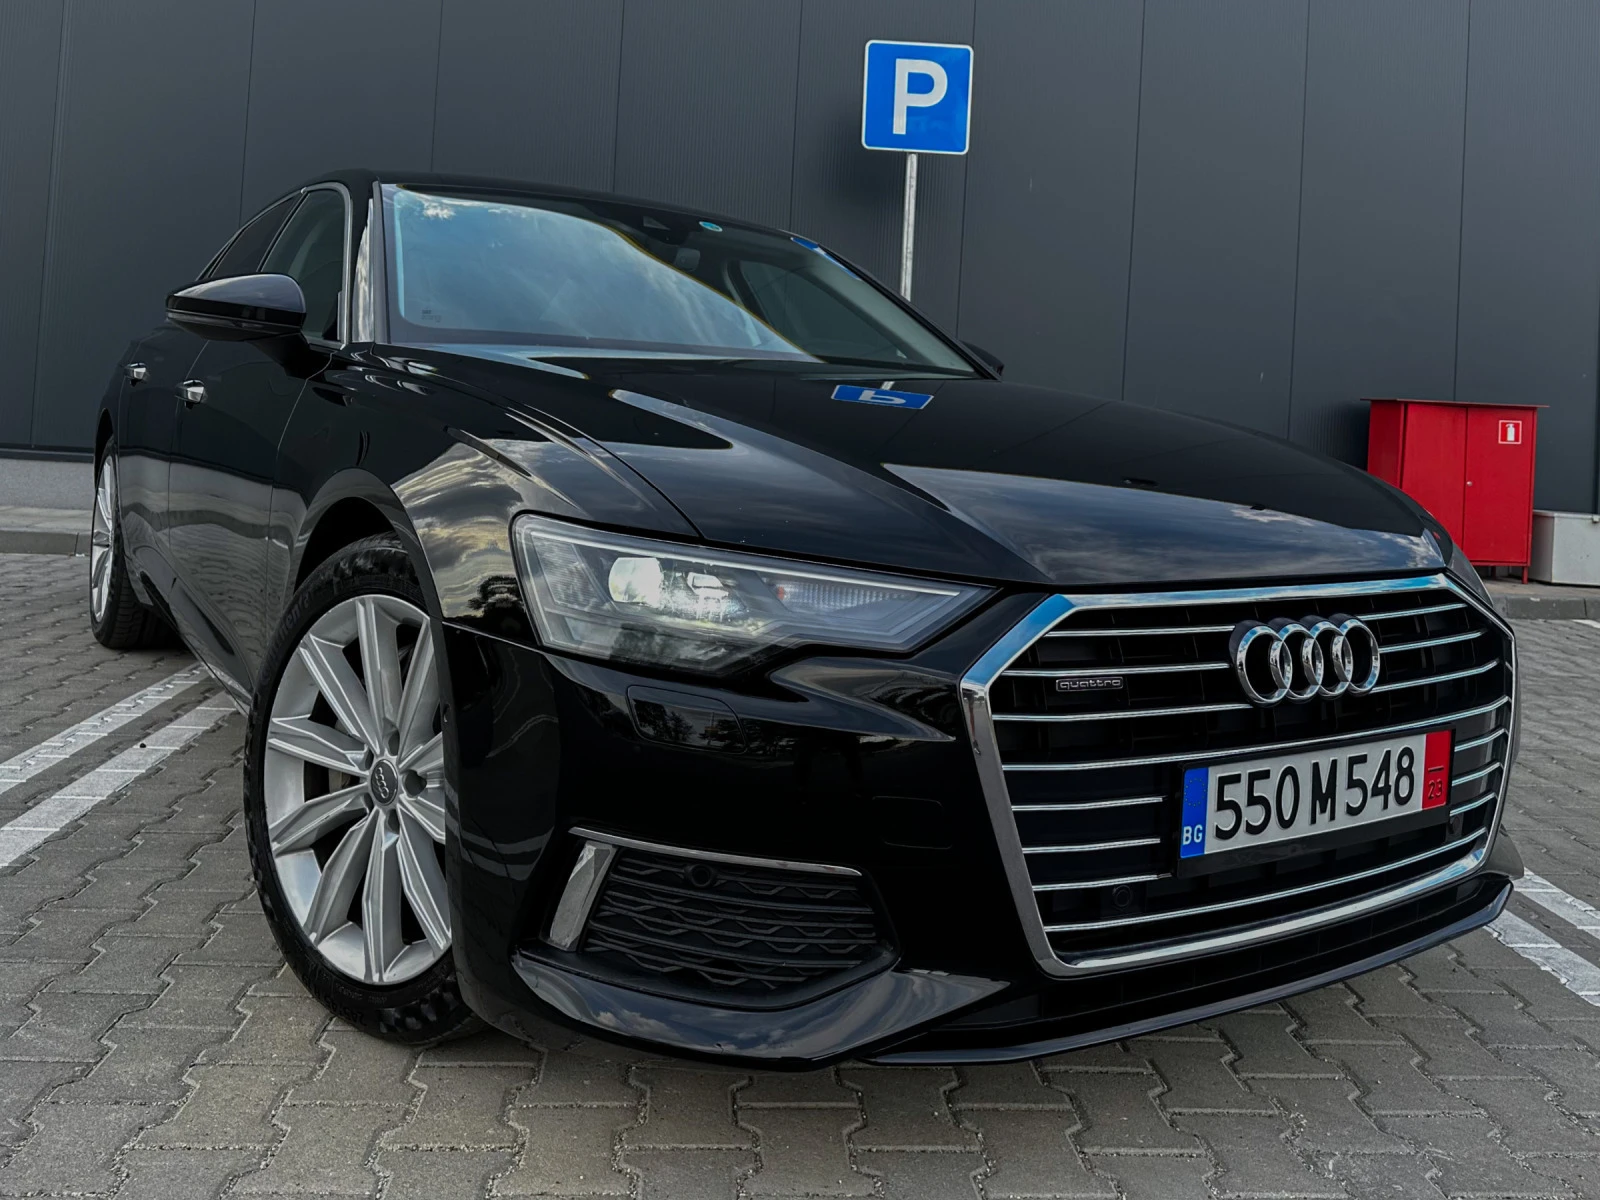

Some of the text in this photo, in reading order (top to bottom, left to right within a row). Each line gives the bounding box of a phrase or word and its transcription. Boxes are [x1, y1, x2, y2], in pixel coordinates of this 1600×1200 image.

[893, 58, 948, 135] P
[1060, 679, 1121, 690] quattro
[1427, 779, 1443, 799] 23
[1183, 824, 1203, 845] BG
